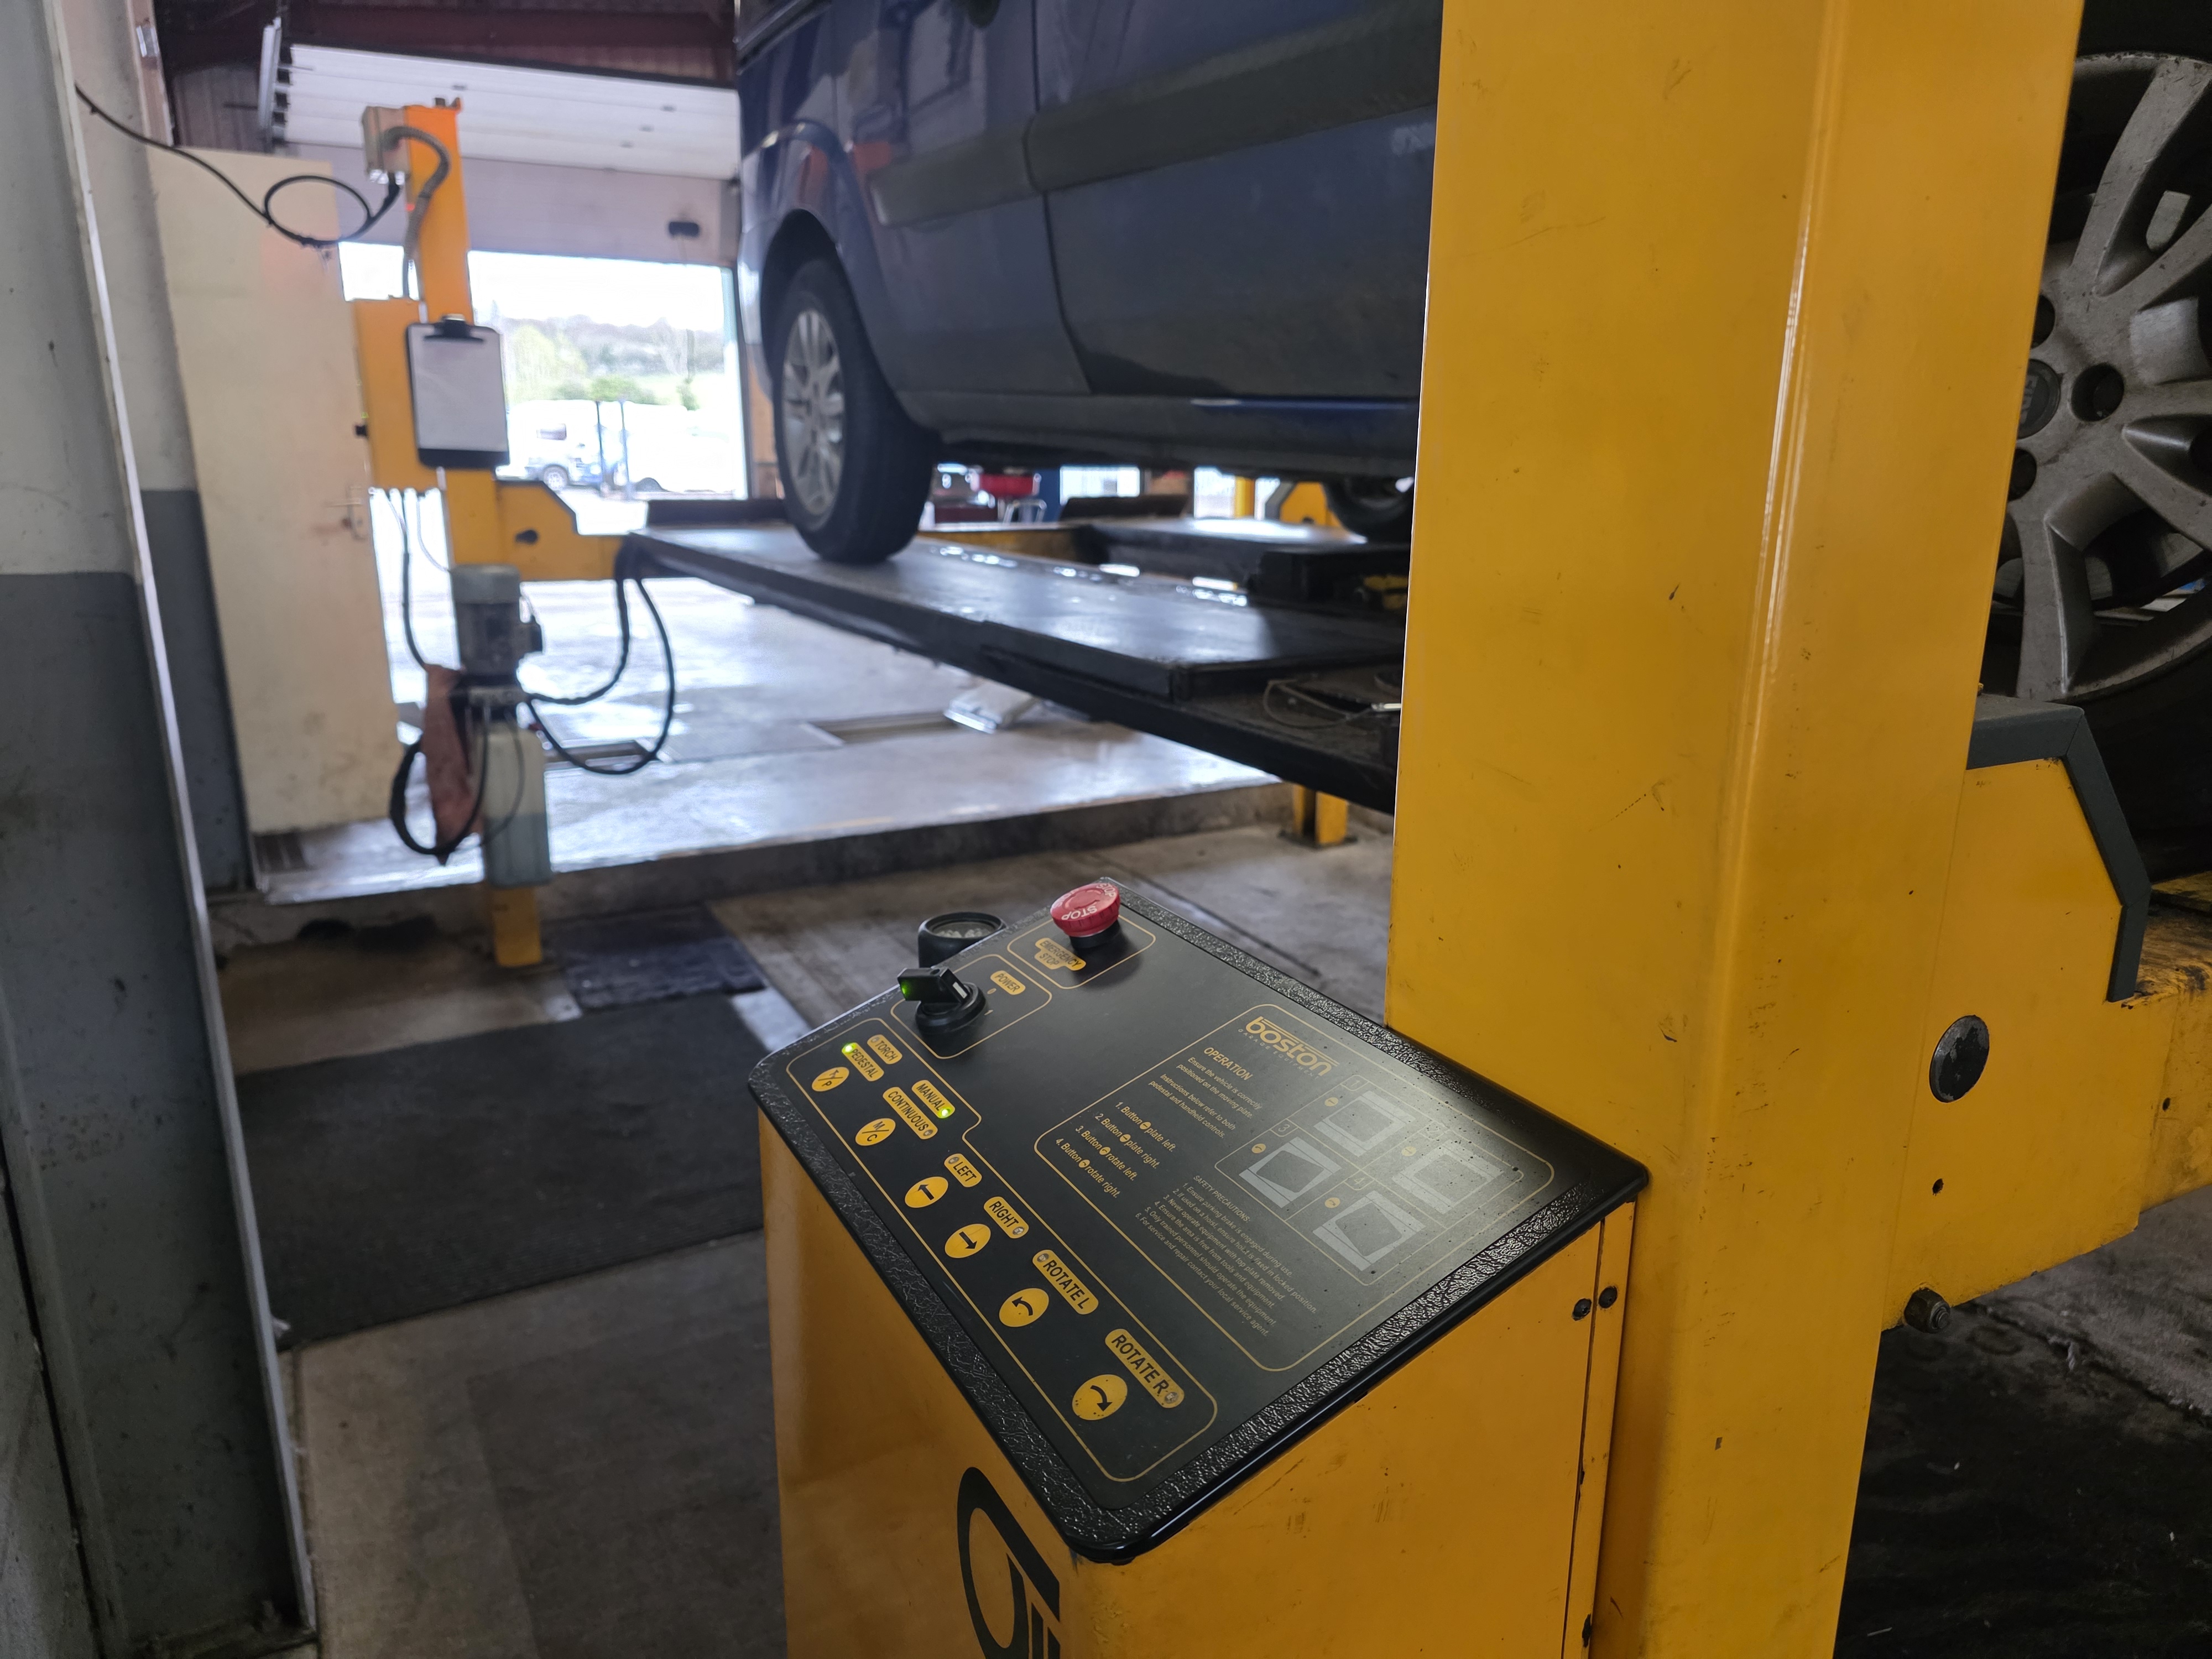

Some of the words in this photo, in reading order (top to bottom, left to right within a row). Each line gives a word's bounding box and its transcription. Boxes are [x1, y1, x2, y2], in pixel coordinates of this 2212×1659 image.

[1061, 905, 1098, 921] STOP
[1096, 883, 1117, 898] STOP
[1039, 953, 1060, 966] STOP
[1040, 940, 1082, 967] EMERGENCY
[994, 973, 1020, 992] POWER
[852, 1048, 878, 1078] PEDESTAL
[875, 1040, 898, 1061] TORCH
[1203, 1047, 1254, 1081] OPERATION
[1238, 1029, 1271, 1050] GARAGE
[1245, 1016, 1343, 1077] boston
[916, 1083, 945, 1112] MANUAL
[1160, 1073, 1190, 1097] Instructions
[1187, 1093, 1205, 1107] below
[1203, 1105, 1218, 1117] refer
[1221, 1119, 1236, 1130] both
[1176, 1064, 1206, 1083] positioned
[1209, 1086, 1220, 1094] the
[1218, 1093, 1239, 1109] moving
[1236, 1106, 1253, 1119] plate.
[1187, 1057, 1207, 1072] Ensure
[1204, 1069, 1215, 1077] the
[1213, 1075, 1233, 1090] vehicle
[1237, 1092, 1264, 1111] correctly
[888, 1091, 929, 1131] CONTINUOUS
[1120, 1106, 1142, 1125] Button
[1144, 1128, 1164, 1142] plate
[1161, 1139, 1176, 1152] left.
[1148, 1081, 1173, 1097] pedestal
[1169, 1095, 1183, 1104] and
[1178, 1102, 1206, 1121] handheld
[1202, 1120, 1225, 1139] controls.
[1278, 1124, 1291, 1132] 3
[1081, 1130, 1103, 1150] Button
[1105, 1153, 1125, 1170] rotate
[1123, 1167, 1138, 1181] left.
[1100, 1118, 1123, 1137] Button
[1123, 1140, 1144, 1155] plate
[1141, 1153, 1160, 1169] right.
[953, 1161, 977, 1182] LEFT
[1060, 1142, 1082, 1162] Button
[1084, 1166, 1104, 1183] rotate
[1102, 1182, 1120, 1198] right.
[989, 1201, 1019, 1228] RIGHT
[1193, 1175, 1215, 1192] SAFETY
[1212, 1190, 1251, 1223] PRECAUTIONS:
[1158, 1204, 1176, 1221] Ensure
[1174, 1219, 1185, 1228] the
[1182, 1227, 1195, 1238] area
[1198, 1240, 1210, 1250] free
[1208, 1249, 1222, 1261] from
[1220, 1259, 1235, 1273] tools
[1233, 1272, 1247, 1282] and
[1167, 1198, 1183, 1212] Never
[1181, 1211, 1201, 1228] operate
[1199, 1226, 1227, 1250] equipment
[1224, 1248, 1237, 1260] with
[1235, 1258, 1246, 1267] top
[1243, 1266, 1260, 1279] plate
[1181, 1196, 1196, 1208] used
[1217, 1227, 1236, 1243] ensure
[1272, 1274, 1295, 1292] locked
[1186, 1186, 1204, 1202] Ensure
[1201, 1201, 1223, 1218] parking
[1220, 1215, 1237, 1229] brake
[1240, 1233, 1266, 1253] engaged
[1262, 1251, 1282, 1268] during
[1139, 1217, 1150, 1226] For
[1147, 1225, 1166, 1241] service
[1164, 1240, 1177, 1250] and
[1173, 1248, 1190, 1262] repair
[1187, 1261, 1208, 1280] contact
[1204, 1278, 1220, 1290] your
[1217, 1288, 1234, 1303] local
[1230, 1301, 1252, 1321] service
[1149, 1211, 1162, 1223] Only
[1160, 1220, 1179, 1237] trained
[1174, 1235, 1203, 1258] personnel
[1199, 1256, 1220, 1274] should
[1216, 1272, 1238, 1291] operate
[1236, 1289, 1247, 1300] the
[1042, 1259, 1086, 1301] ROTATE
[1077, 1297, 1090, 1310] L
[1111, 1334, 1161, 1384] ROTATE
[1152, 1379, 1170, 1395] R
